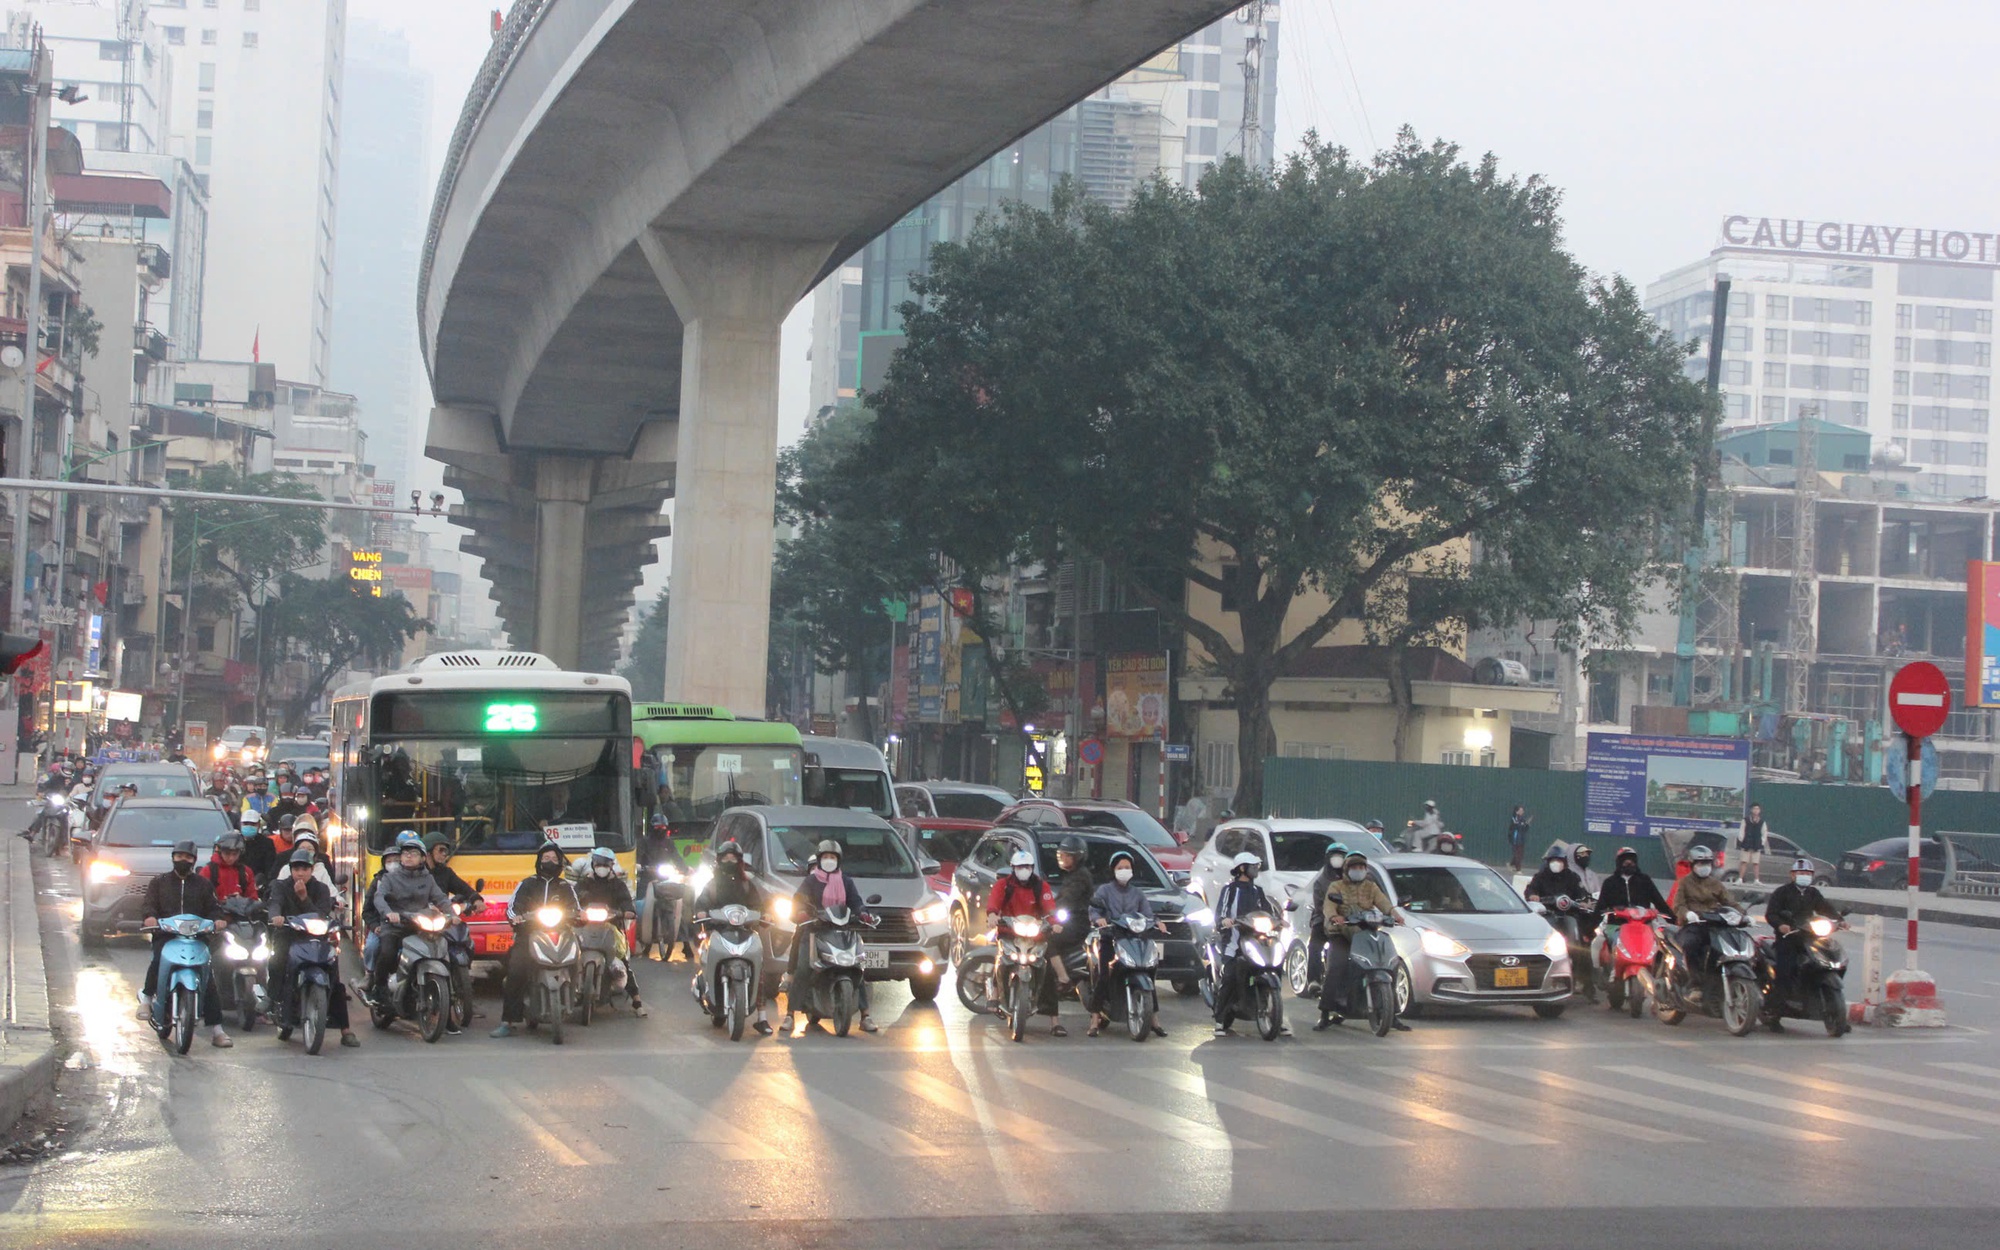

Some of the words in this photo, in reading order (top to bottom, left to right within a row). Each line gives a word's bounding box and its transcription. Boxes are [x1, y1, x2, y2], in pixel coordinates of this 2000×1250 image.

[1723, 215, 1804, 249] CAU
[1816, 222, 1904, 256] GIAY
[352, 548, 382, 562] VÀNG
[486, 703, 537, 731] 26
[546, 828, 560, 840] 26
